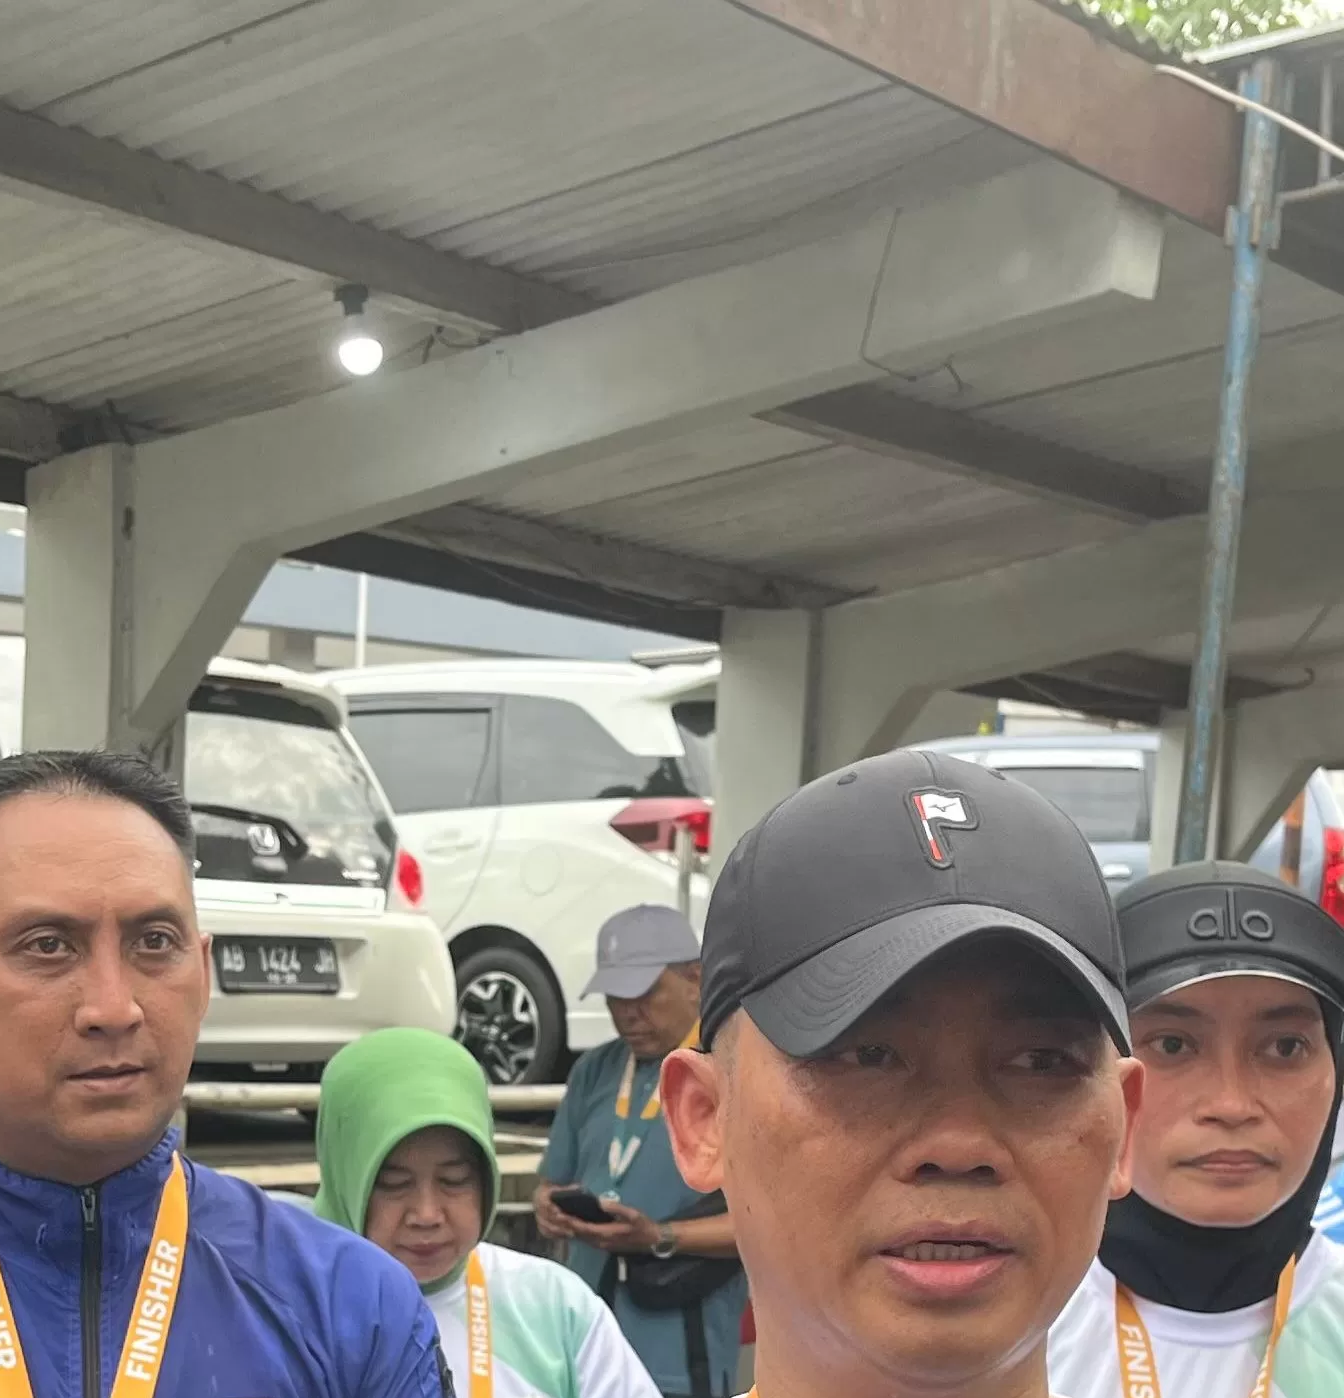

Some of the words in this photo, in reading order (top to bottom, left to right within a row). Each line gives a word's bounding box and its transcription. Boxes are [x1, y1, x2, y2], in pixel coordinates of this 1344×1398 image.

[1186, 889, 1274, 942] alo
[258, 946, 301, 973] 1424
[126, 1239, 181, 1381] FINISHER
[470, 1284, 489, 1377] FINISHER
